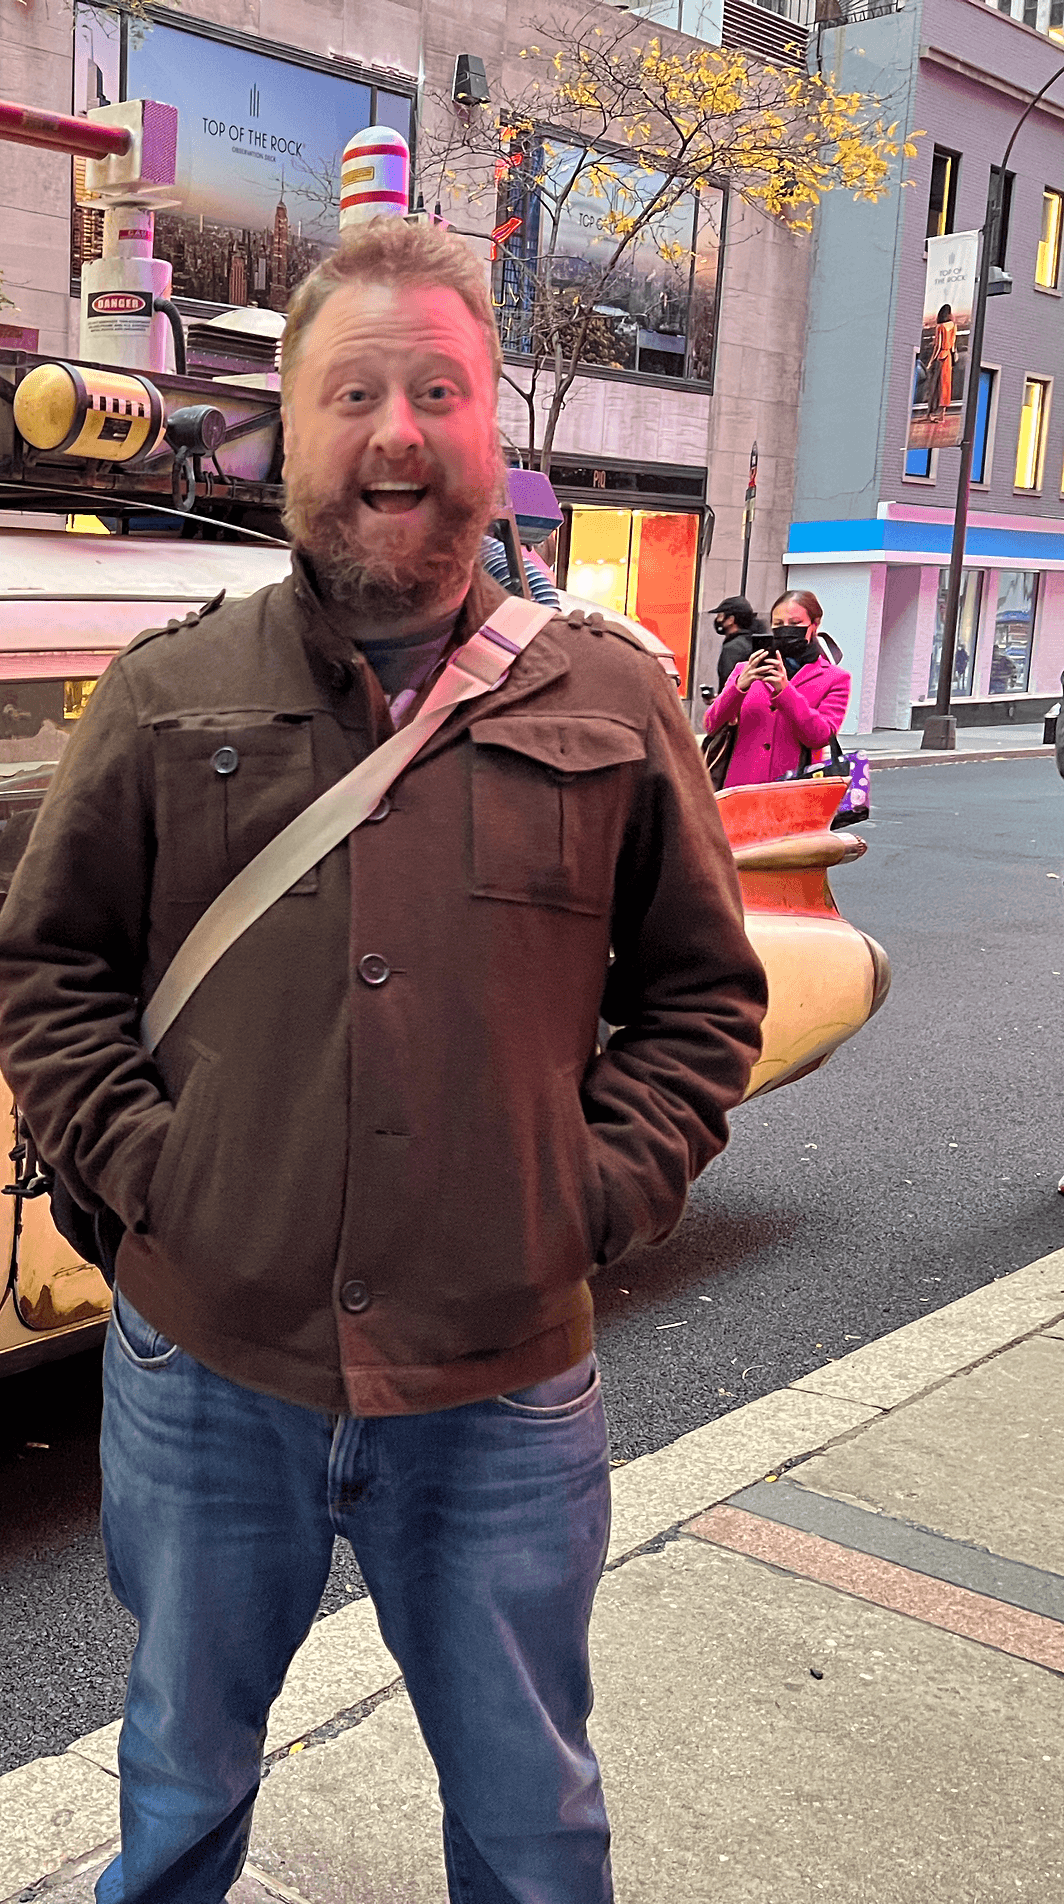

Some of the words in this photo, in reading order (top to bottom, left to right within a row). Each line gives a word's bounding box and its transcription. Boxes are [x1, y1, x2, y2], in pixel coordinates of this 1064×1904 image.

[202, 117, 226, 137] TOP
[228, 125, 245, 142] OF
[248, 129, 268, 149] THE
[270, 135, 303, 157] ROCK
[97, 298, 139, 309] DANGER
